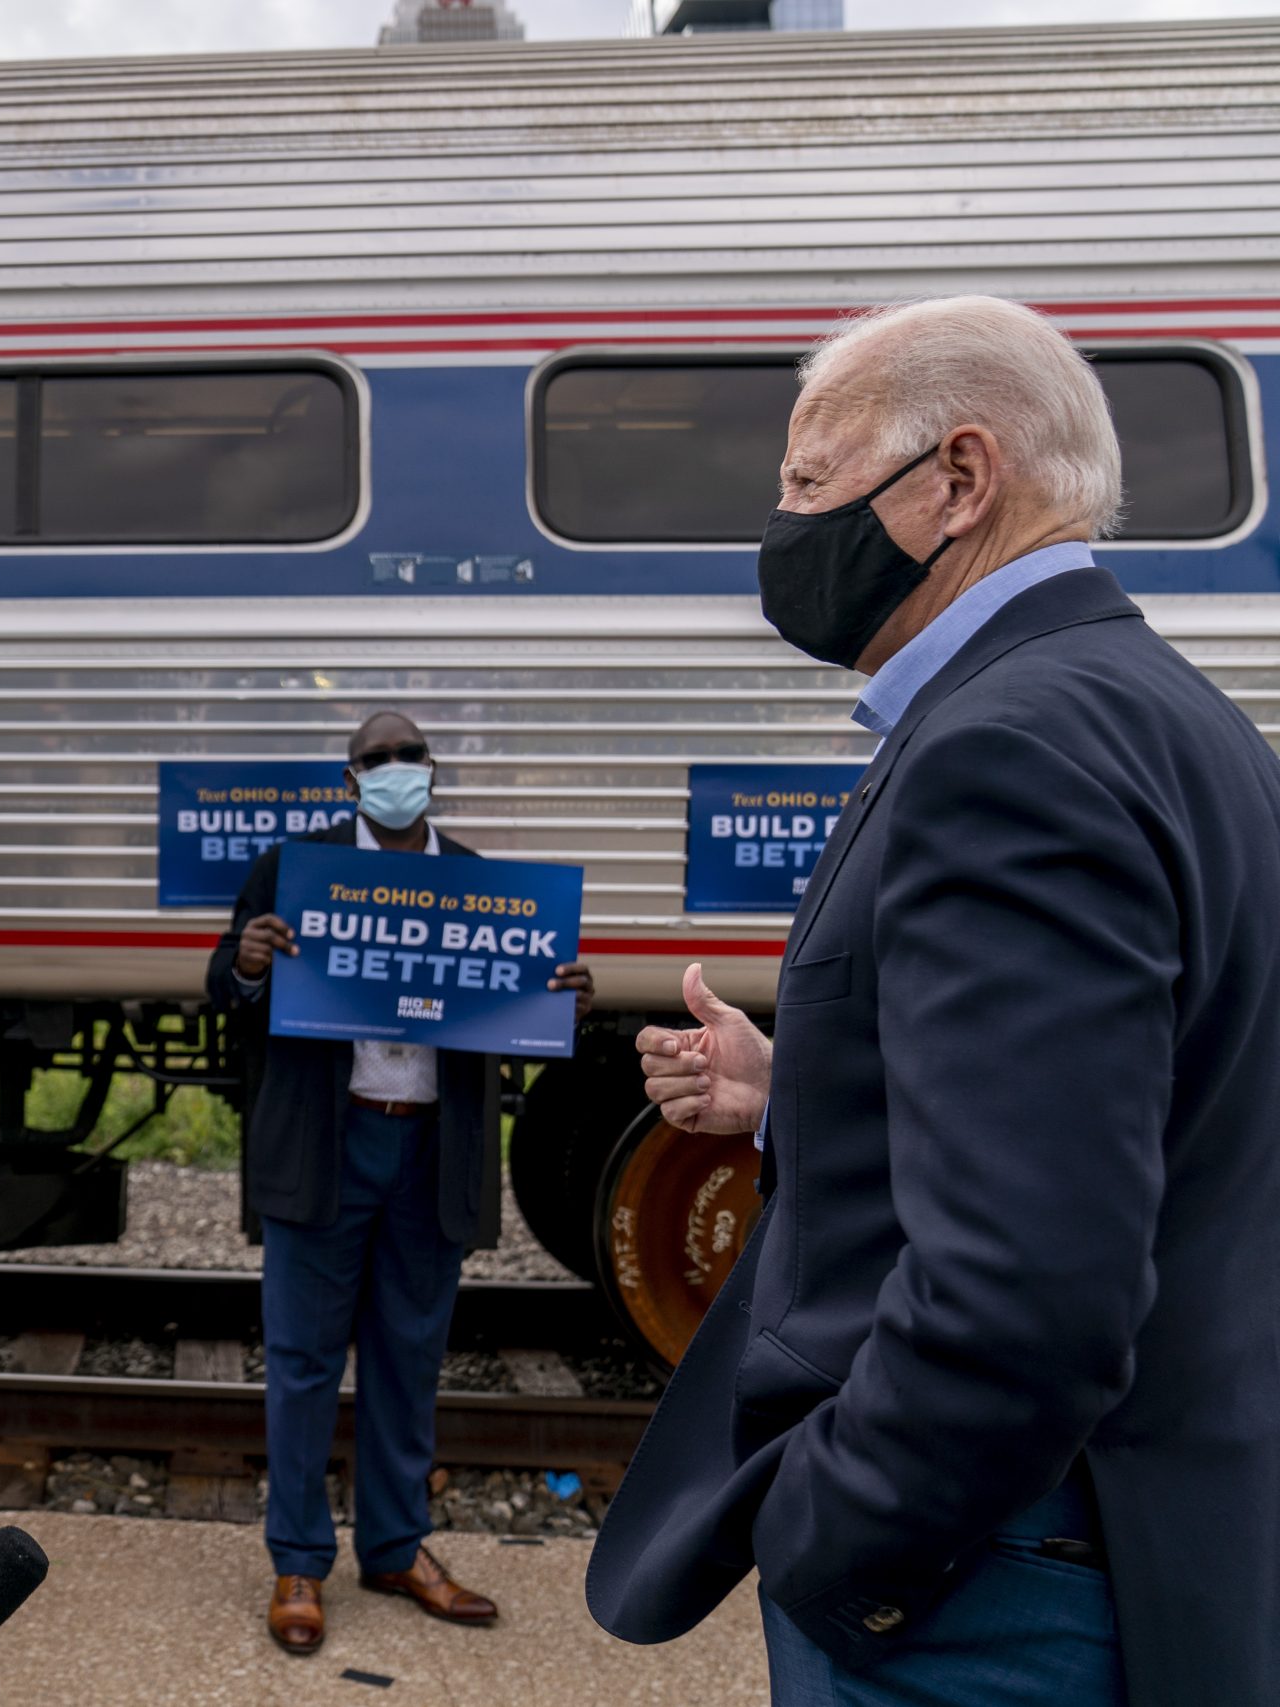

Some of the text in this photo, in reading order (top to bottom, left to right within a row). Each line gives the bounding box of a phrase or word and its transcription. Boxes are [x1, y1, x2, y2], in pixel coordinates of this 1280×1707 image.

[230, 787, 279, 803] OHIO
[766, 792, 817, 808] OHIO
[177, 810, 277, 832] BUILD
[711, 815, 815, 838] BUILD
[201, 836, 287, 861] BET
[735, 842, 825, 868] BET
[330, 883, 538, 918] Text OHIO to 30330
[300, 909, 557, 958] BUILD BACK
[327, 945, 521, 993] BETTER
[397, 1007, 443, 1021] HARRIS
[399, 996, 444, 1012] BIDEN
